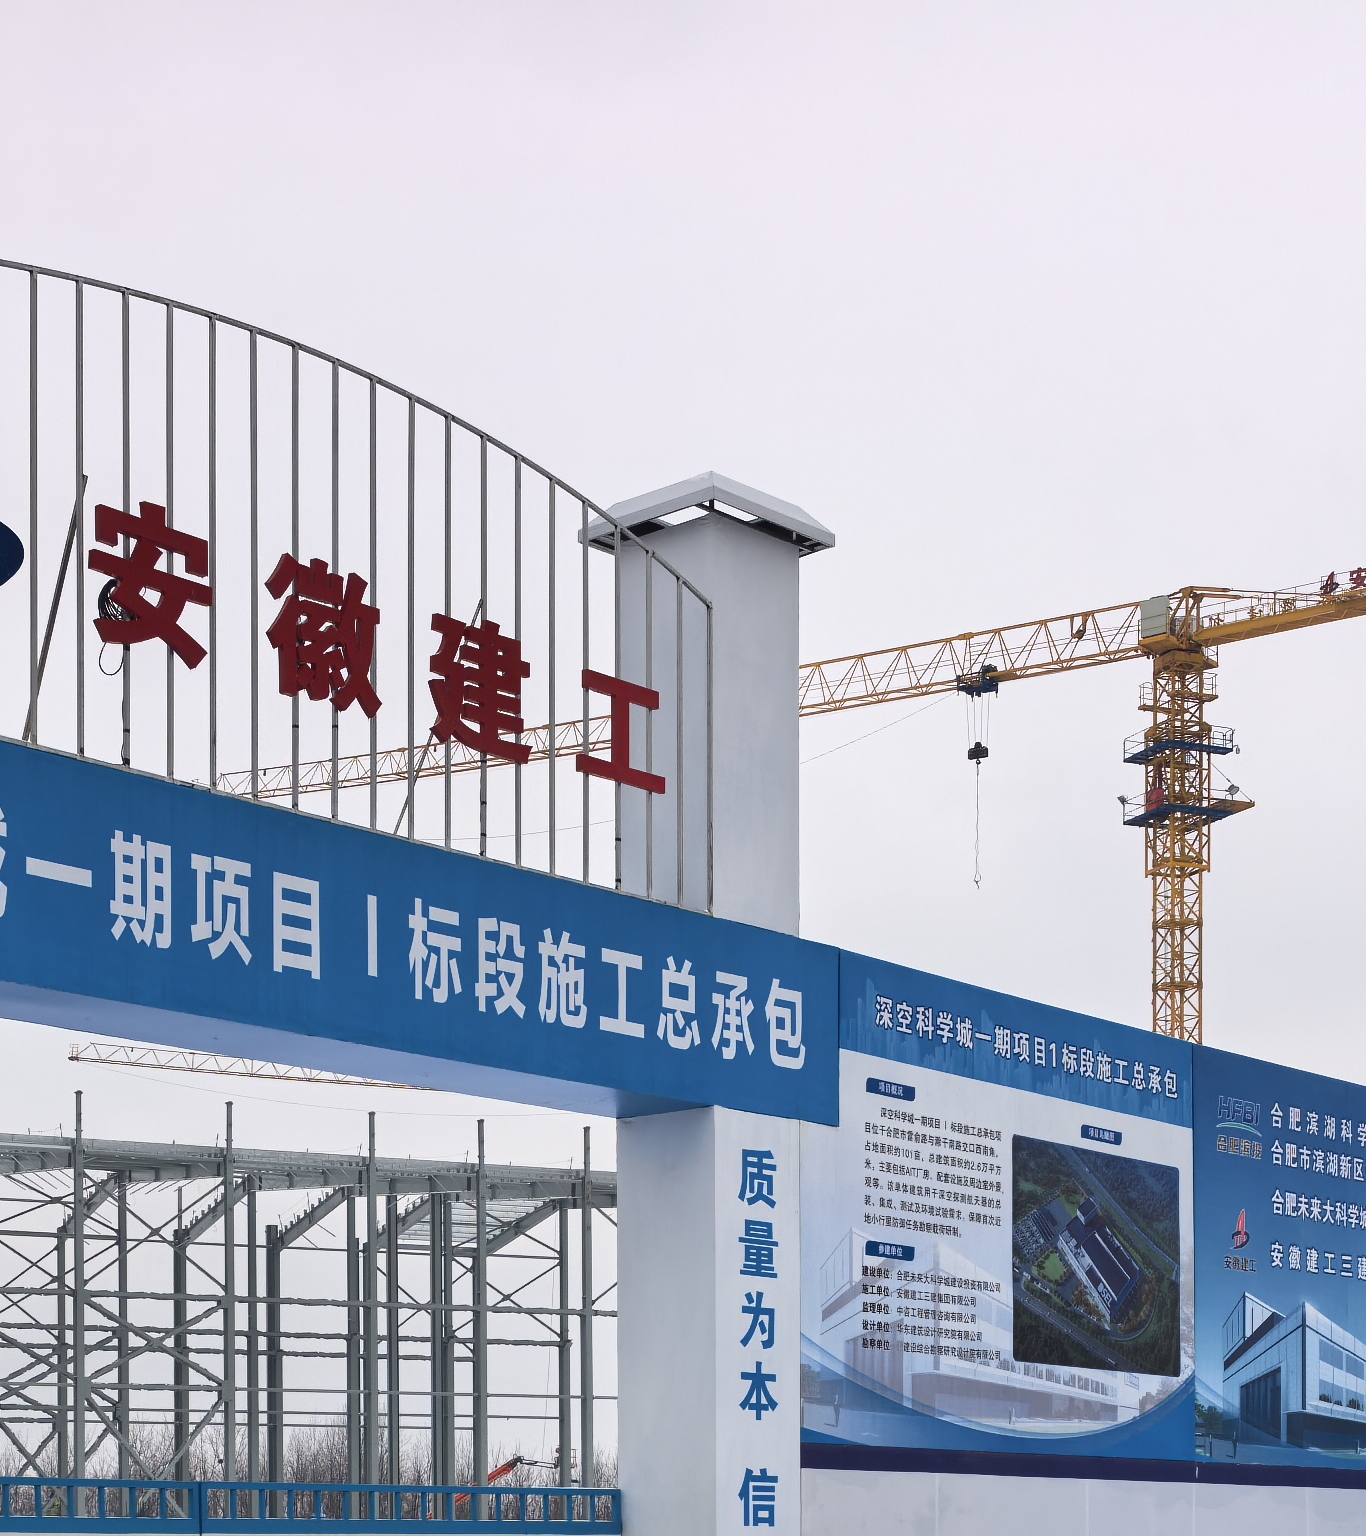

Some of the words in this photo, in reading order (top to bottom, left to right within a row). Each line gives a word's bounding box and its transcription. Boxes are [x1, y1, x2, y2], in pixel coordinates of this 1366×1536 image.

[88, 501, 666, 795] 安徽建工
[875, 995, 1179, 1100] 深空科学城一期项目1标段施工总承包
[1217, 1095, 1260, 1127] HFBI
[738, 1149, 778, 1421] 质量为本
[1223, 1255, 1257, 1272] 安徽建工
